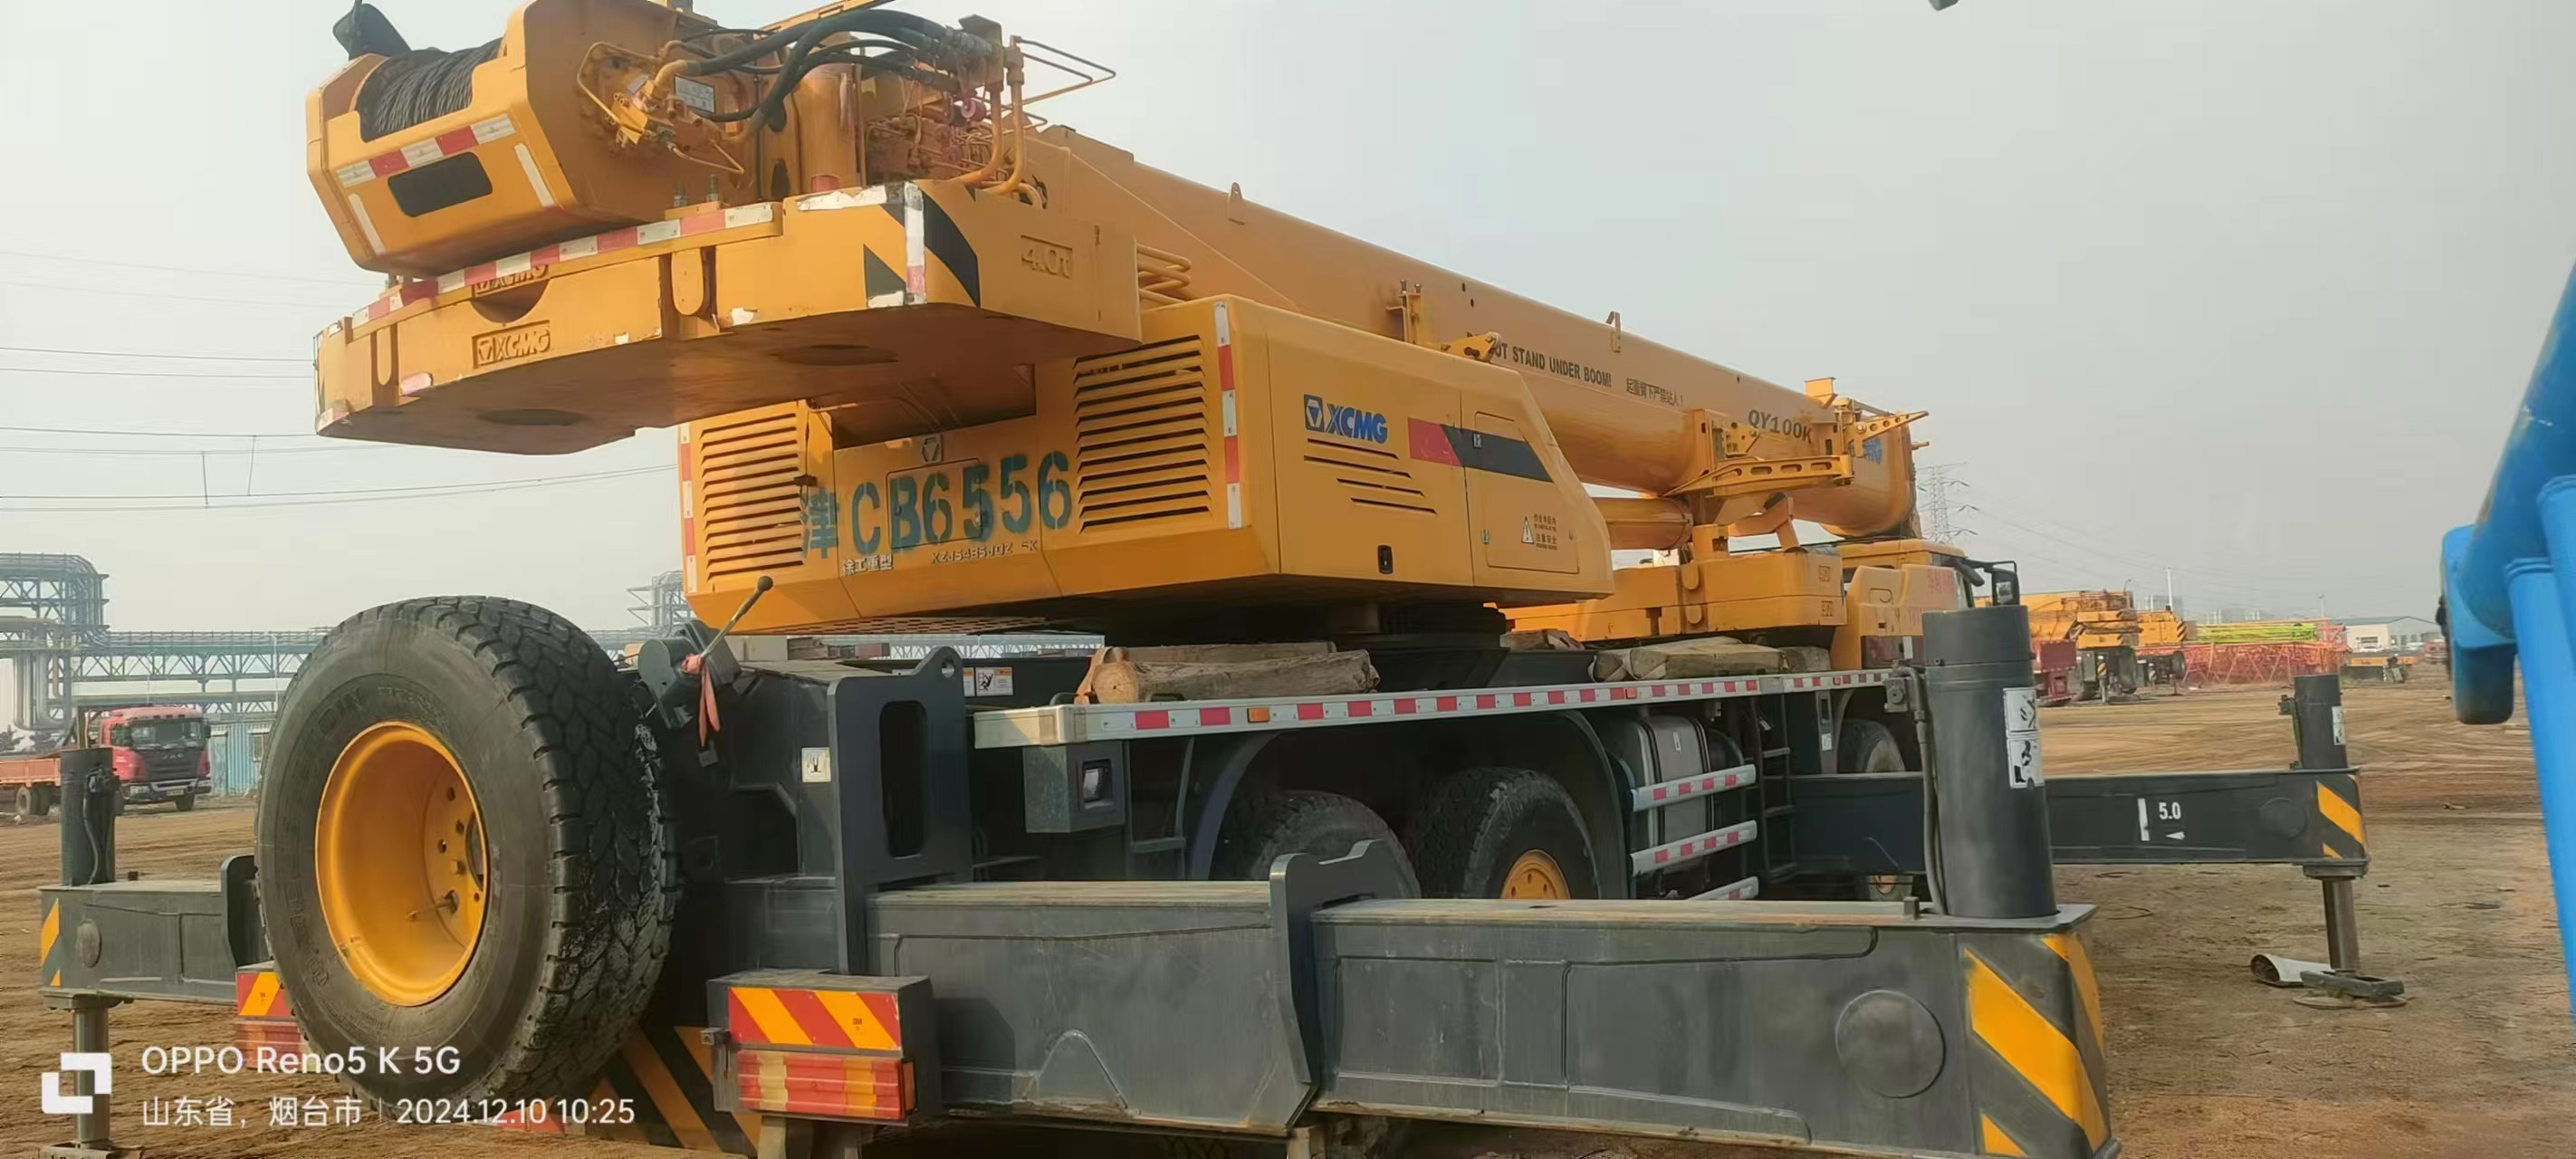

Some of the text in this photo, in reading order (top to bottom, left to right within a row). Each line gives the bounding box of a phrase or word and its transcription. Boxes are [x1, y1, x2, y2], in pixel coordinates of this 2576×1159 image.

[496, 329, 551, 361] XCMG
[1513, 348, 1546, 370] STAND
[1549, 357, 1581, 379] UNDER
[1584, 367, 1612, 388] BOOM!
[1326, 402, 1388, 444] XCMG
[1748, 409, 1812, 445] QY100K
[842, 553, 893, 576] 徐工重型
[2159, 801, 2182, 819] 5.0
